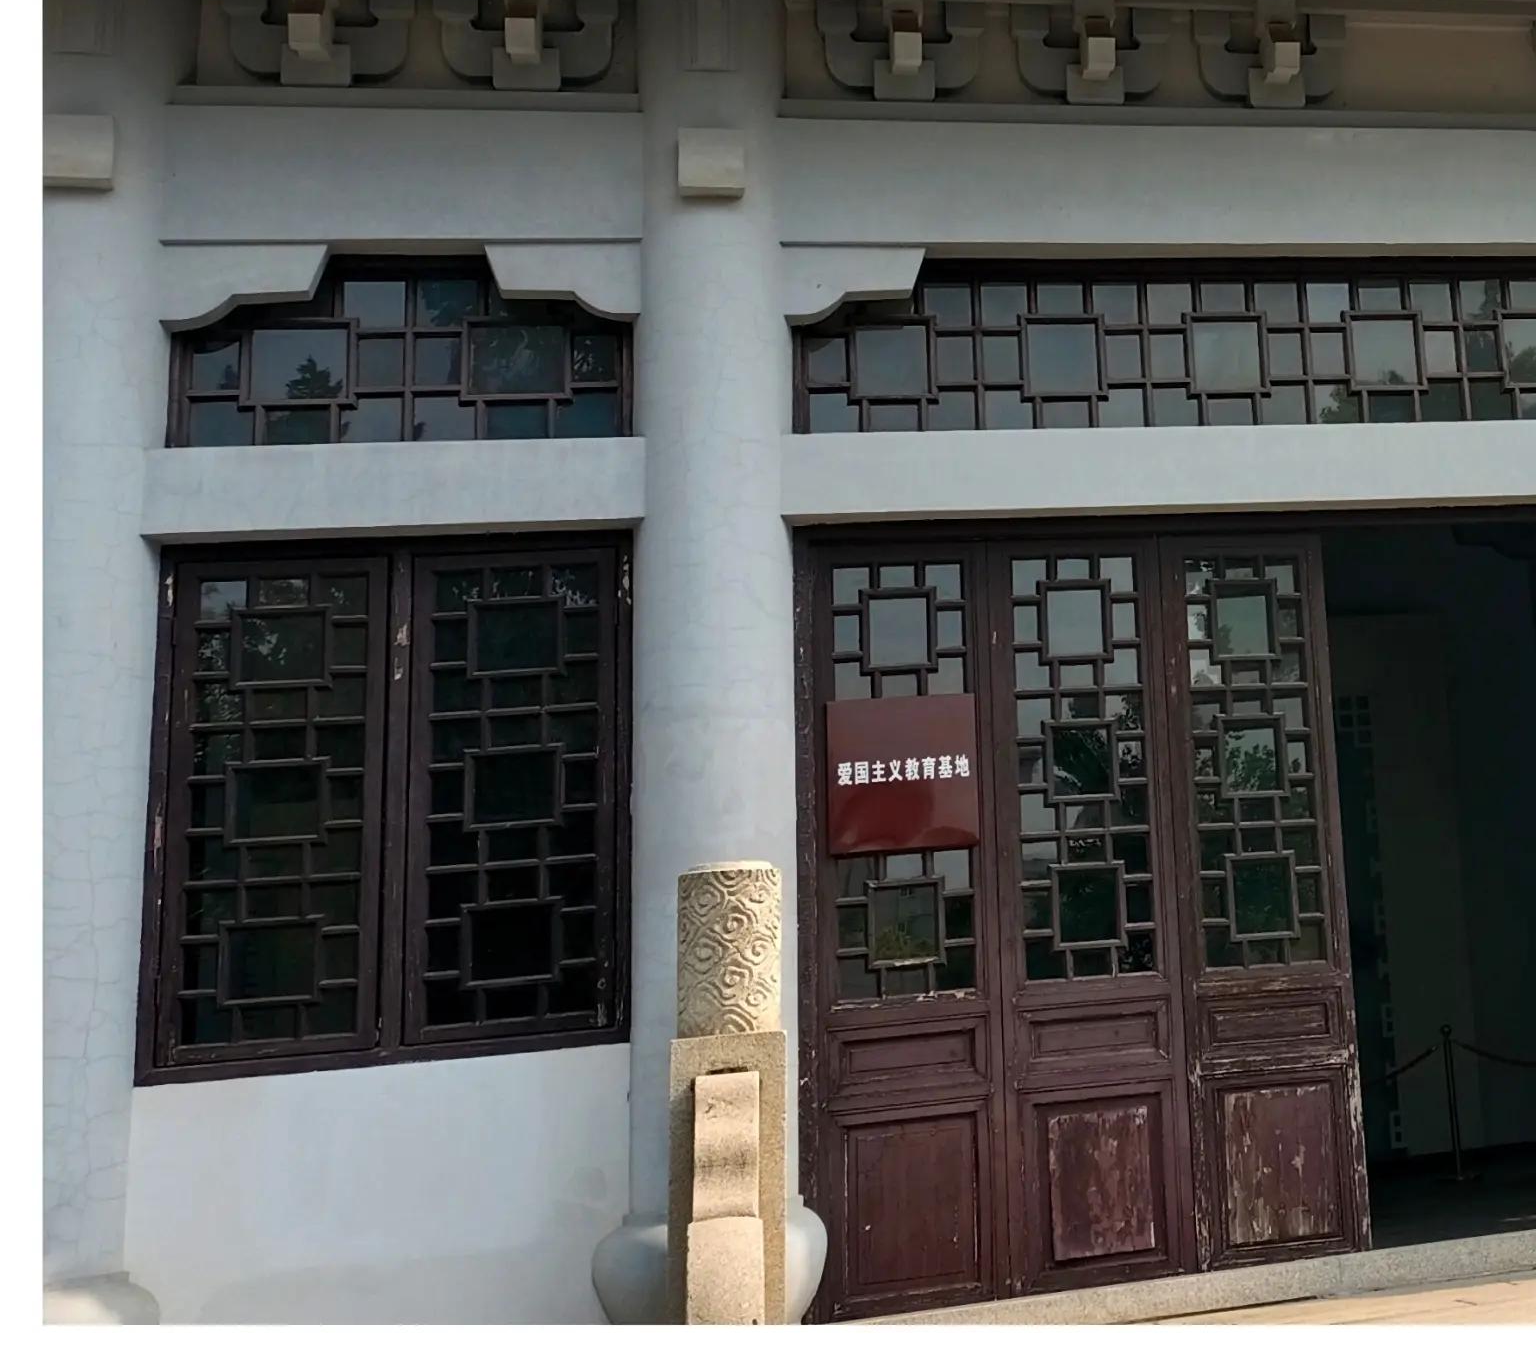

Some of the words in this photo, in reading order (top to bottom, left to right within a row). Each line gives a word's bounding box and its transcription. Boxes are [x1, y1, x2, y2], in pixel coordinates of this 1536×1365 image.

[837, 754, 970, 786] 爱国主义教育基地
